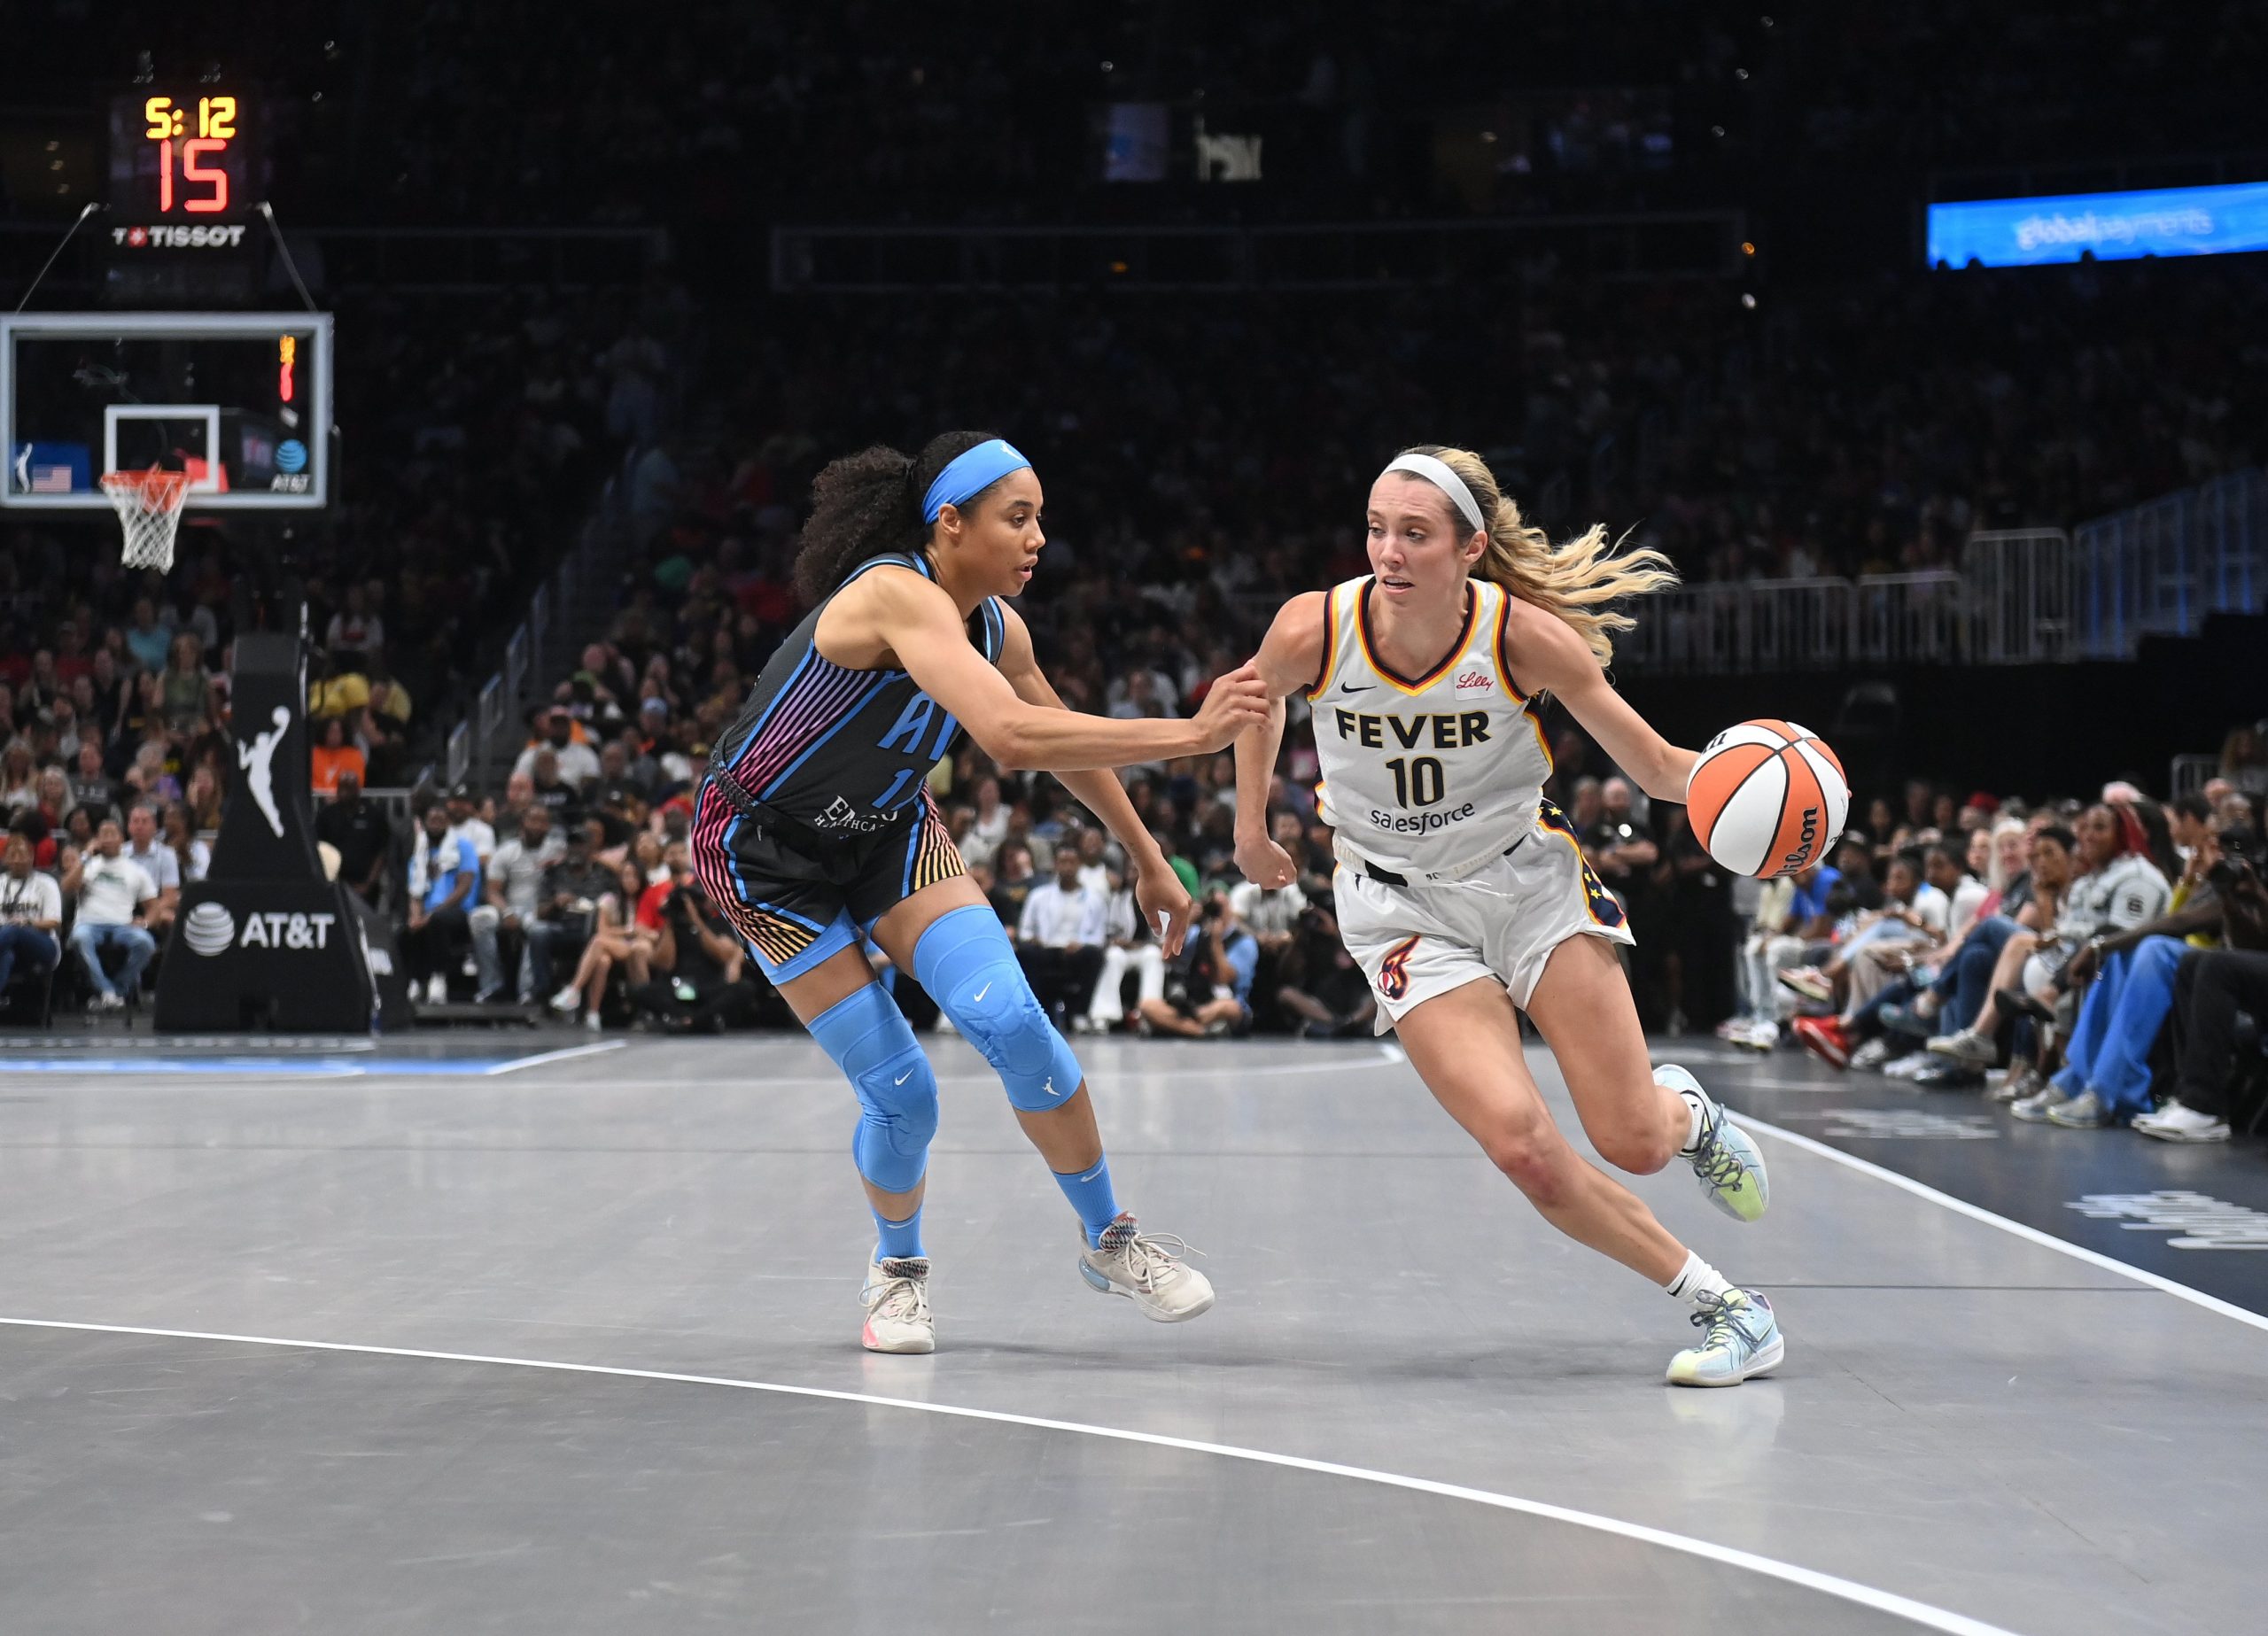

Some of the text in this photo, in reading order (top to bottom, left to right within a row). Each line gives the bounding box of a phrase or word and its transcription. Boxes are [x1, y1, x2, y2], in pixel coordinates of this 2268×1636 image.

[145, 97, 237, 139] 5:12
[160, 138, 228, 213] 15
[149, 224, 245, 247] TISSOT
[1456, 671, 1495, 691] Lilly
[1334, 708, 1492, 749] FEVER
[872, 768, 915, 810] 1
[1385, 756, 1445, 810] 10
[1370, 802, 1475, 835] salesforce
[239, 911, 336, 949] AT&T
